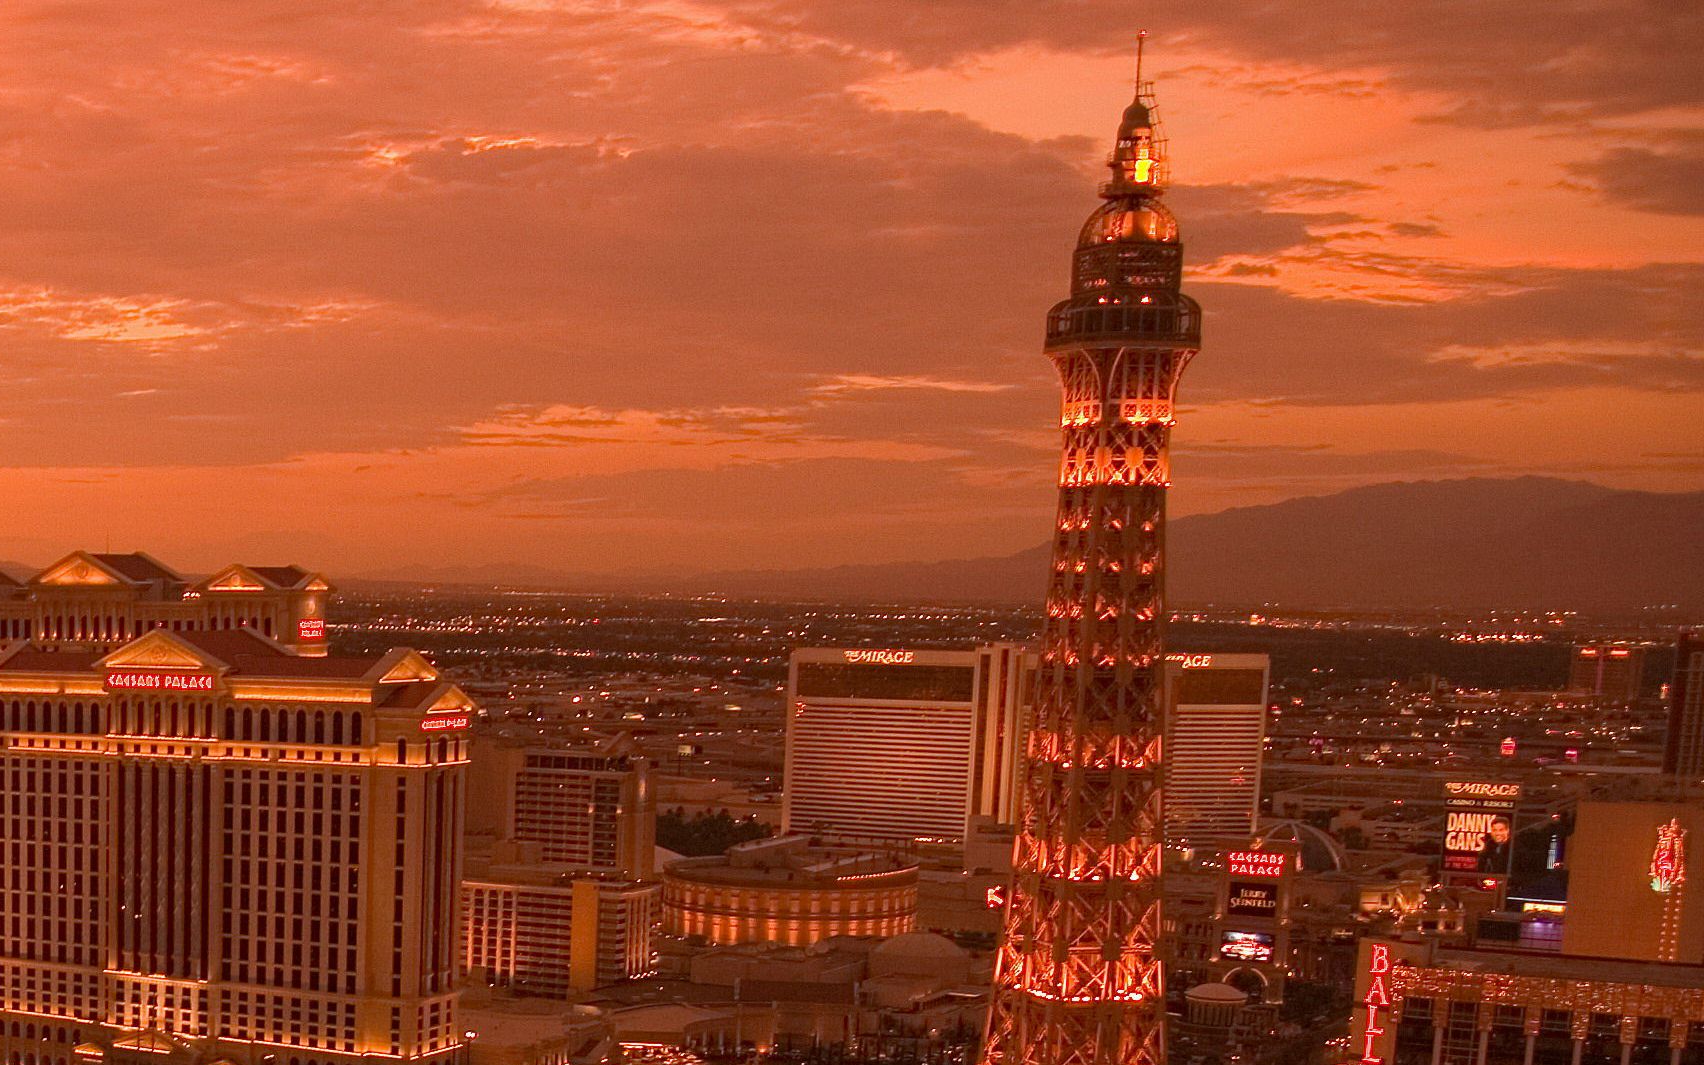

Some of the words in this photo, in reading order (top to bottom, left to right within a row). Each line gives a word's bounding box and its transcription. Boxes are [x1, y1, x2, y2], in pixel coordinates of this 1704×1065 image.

[850, 650, 914, 664] MIRAGE
[108, 674, 160, 688] CAESARS
[164, 675, 212, 689] PALACE
[1450, 783, 1520, 796] MIRAGE
[1447, 812, 1496, 833] DANNY
[1445, 831, 1486, 852] GANS
[1229, 852, 1284, 865] CAESARS
[1231, 863, 1280, 875] PALACE
